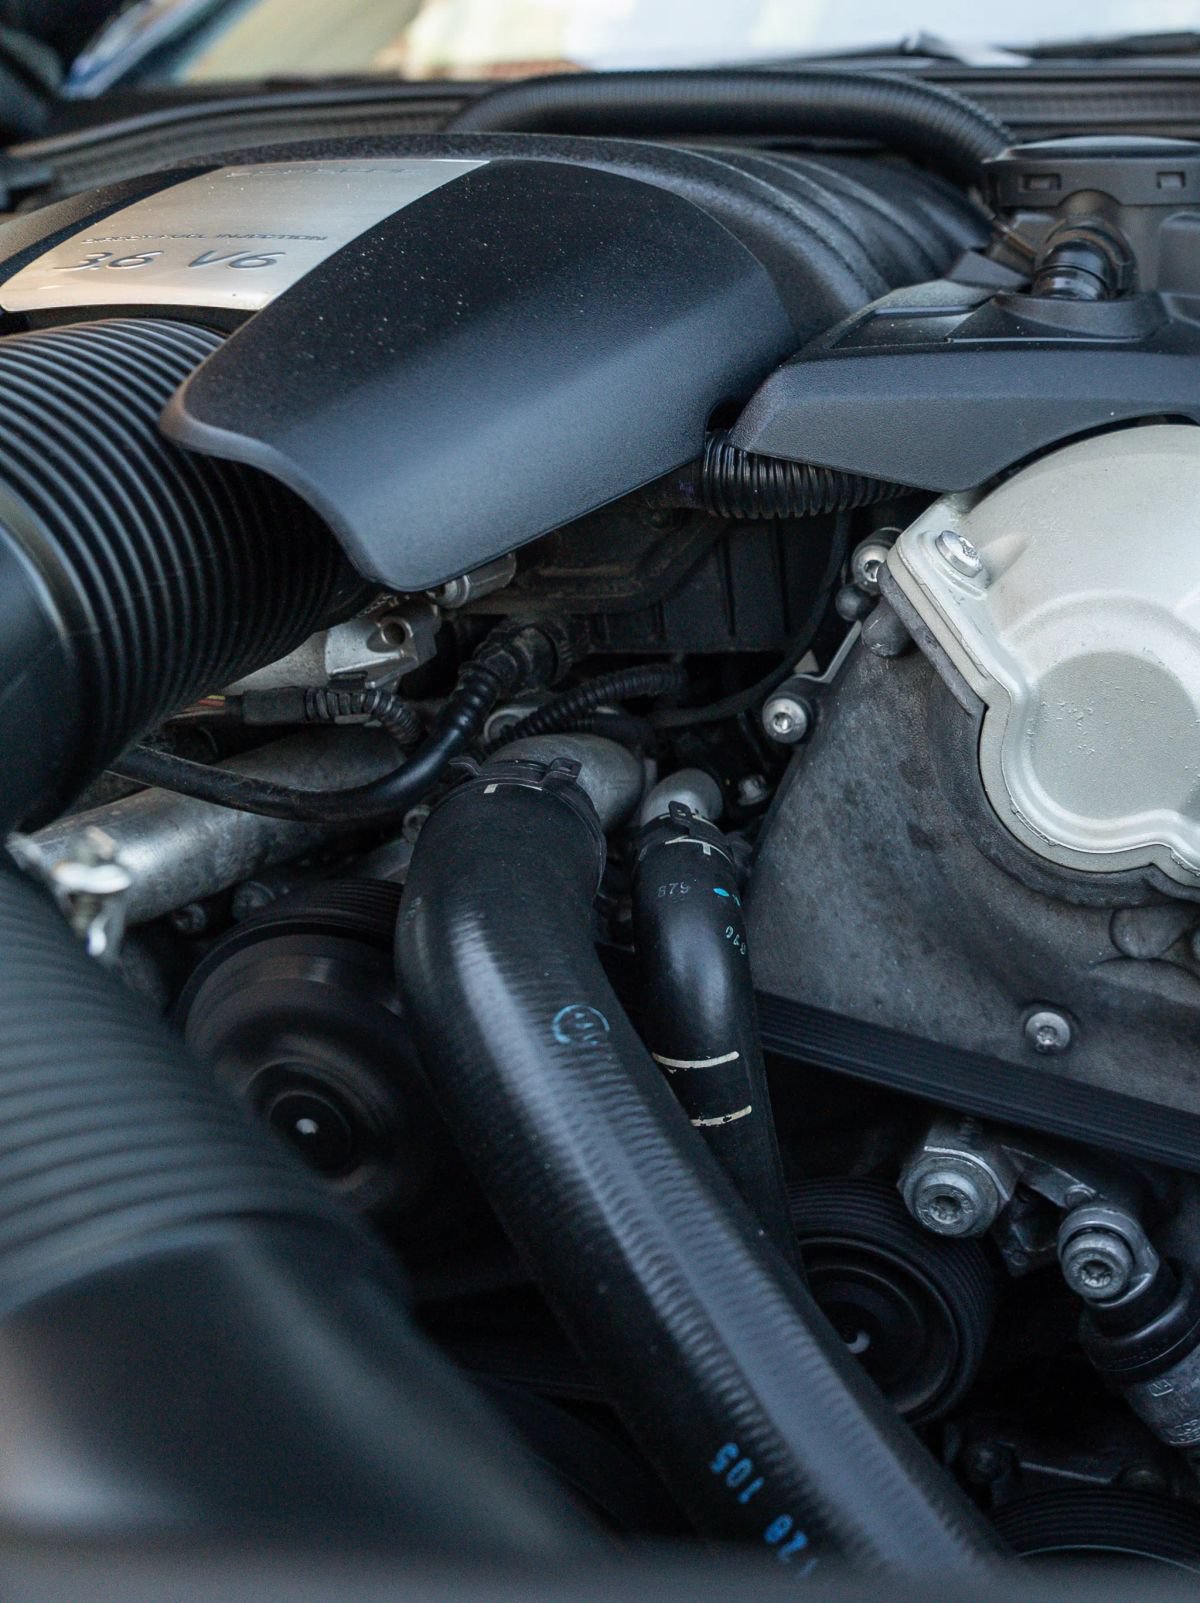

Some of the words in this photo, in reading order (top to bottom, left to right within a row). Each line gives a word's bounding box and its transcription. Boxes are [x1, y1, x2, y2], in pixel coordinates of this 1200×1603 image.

[215, 233, 329, 241] INJECTION
[53, 250, 164, 271] 3.6
[186, 250, 287, 271] V6
[709, 1442, 765, 1504] 105
